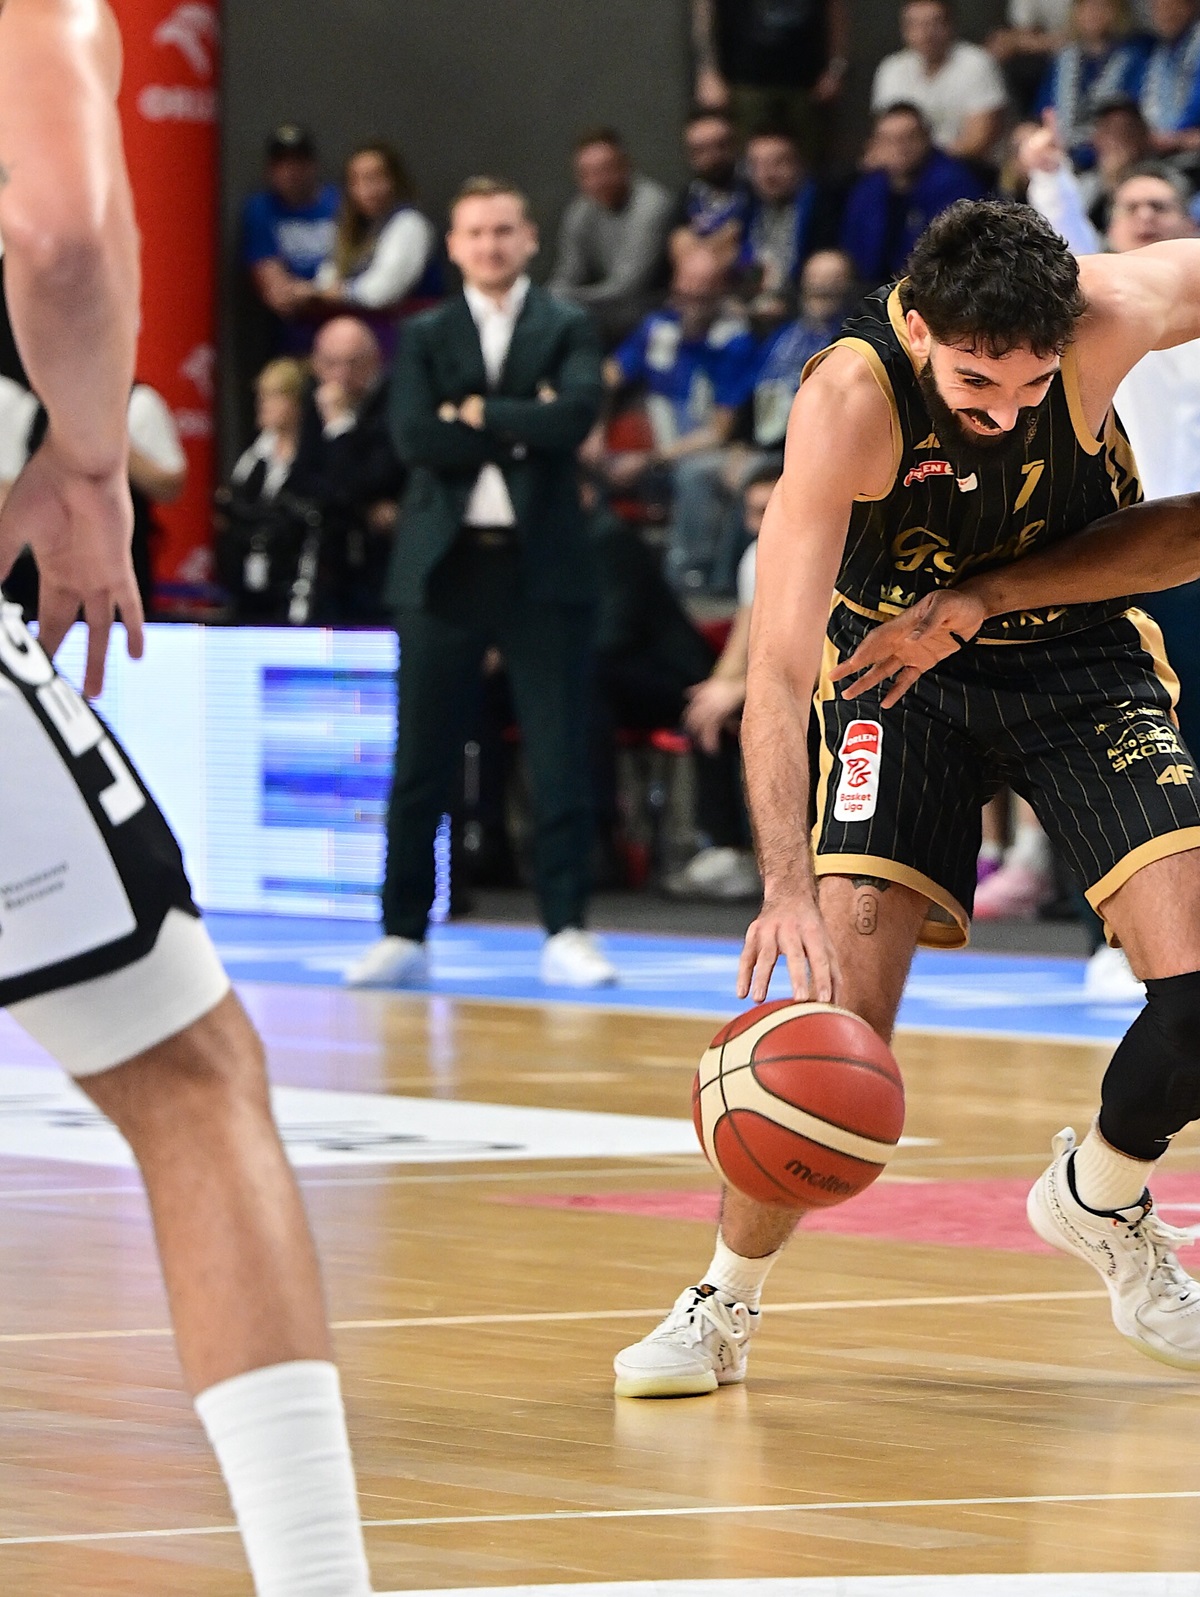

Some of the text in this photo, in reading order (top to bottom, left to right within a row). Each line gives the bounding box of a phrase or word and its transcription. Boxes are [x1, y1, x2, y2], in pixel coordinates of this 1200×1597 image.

[846, 733, 877, 747] ORLEN
[1107, 739, 1137, 759] Auto
[840, 793, 871, 802] Basket
[844, 802, 863, 812] Liga
